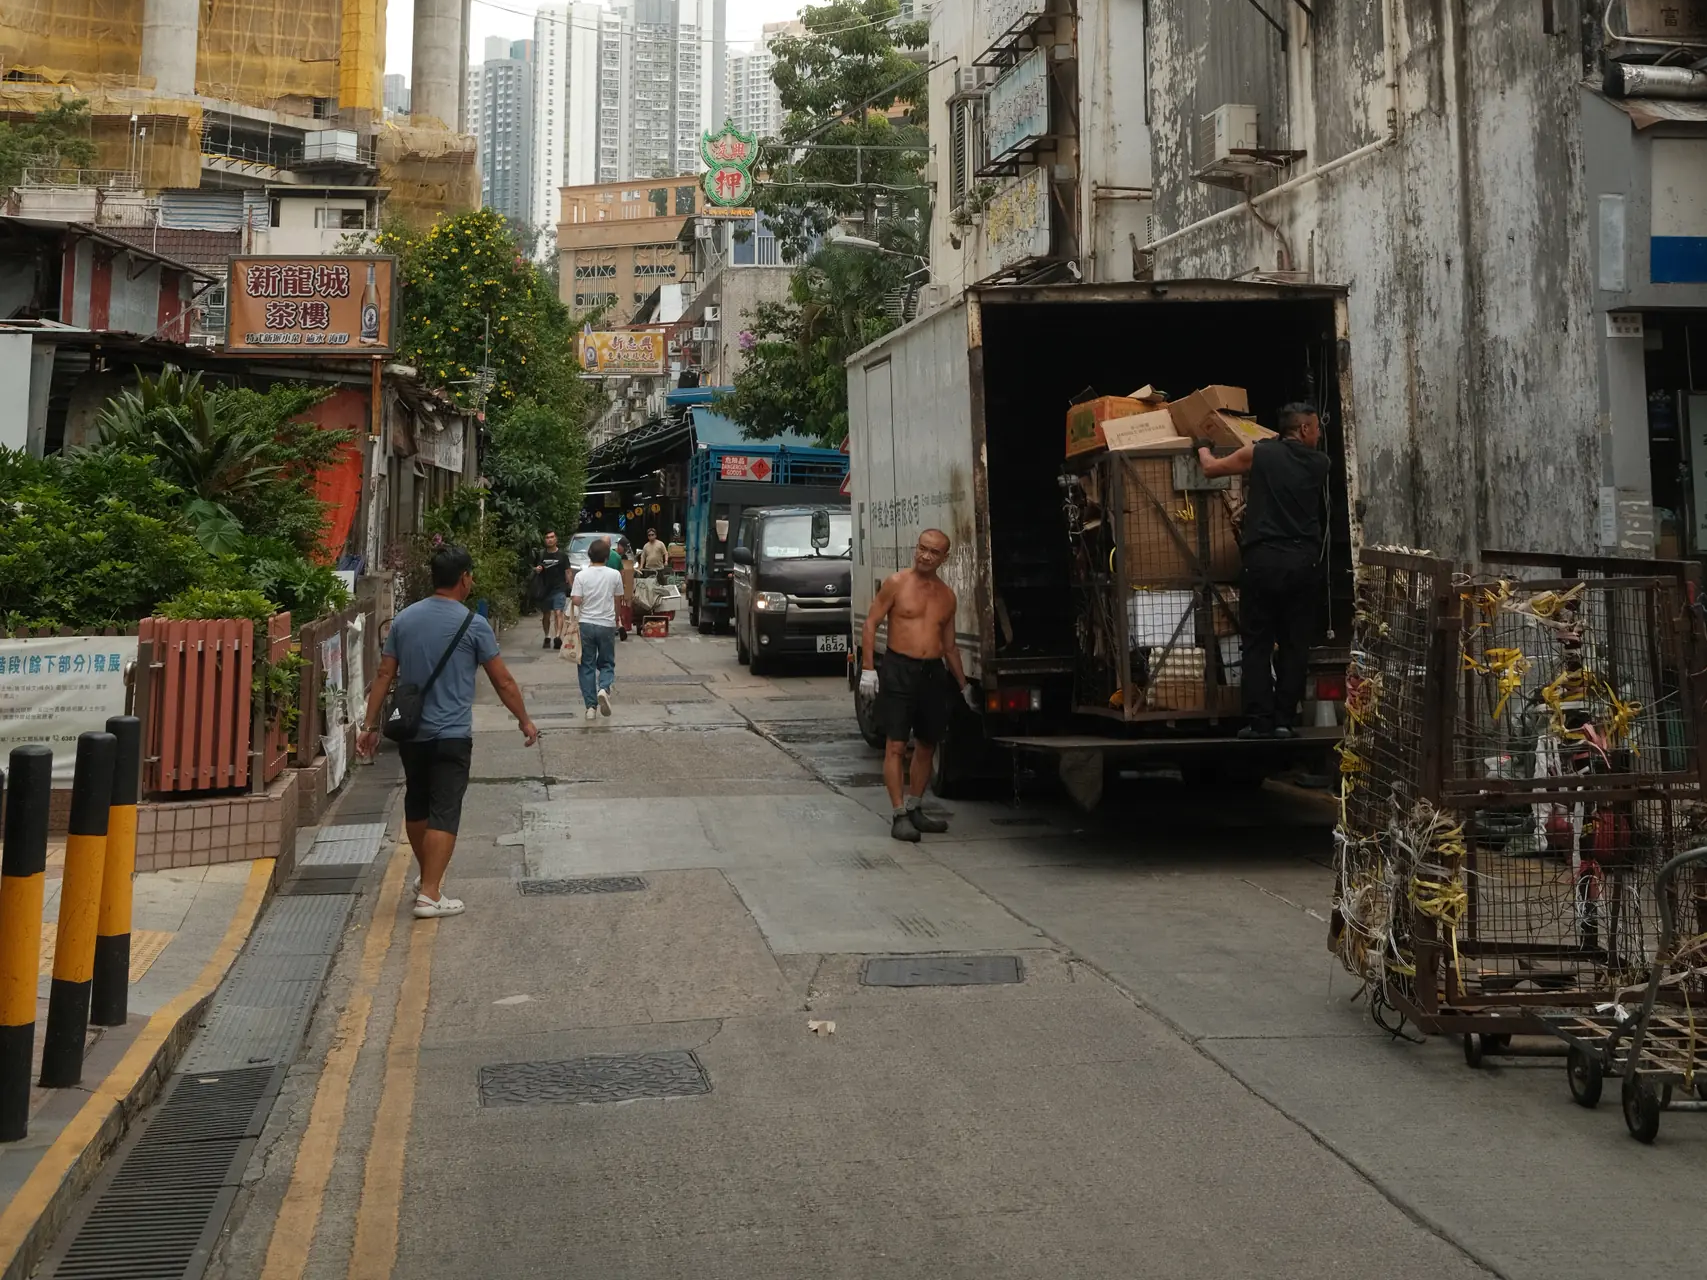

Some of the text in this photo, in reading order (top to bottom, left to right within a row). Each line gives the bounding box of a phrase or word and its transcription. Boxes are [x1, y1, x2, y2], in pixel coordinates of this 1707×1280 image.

[716, 170, 742, 199] 押
[247, 264, 350, 297] 新龍城
[266, 301, 329, 329] 茶樓
[328, 333, 349, 344] 海鮮
[820, 643, 845, 651] 4842
[825, 635, 838, 644] FE
